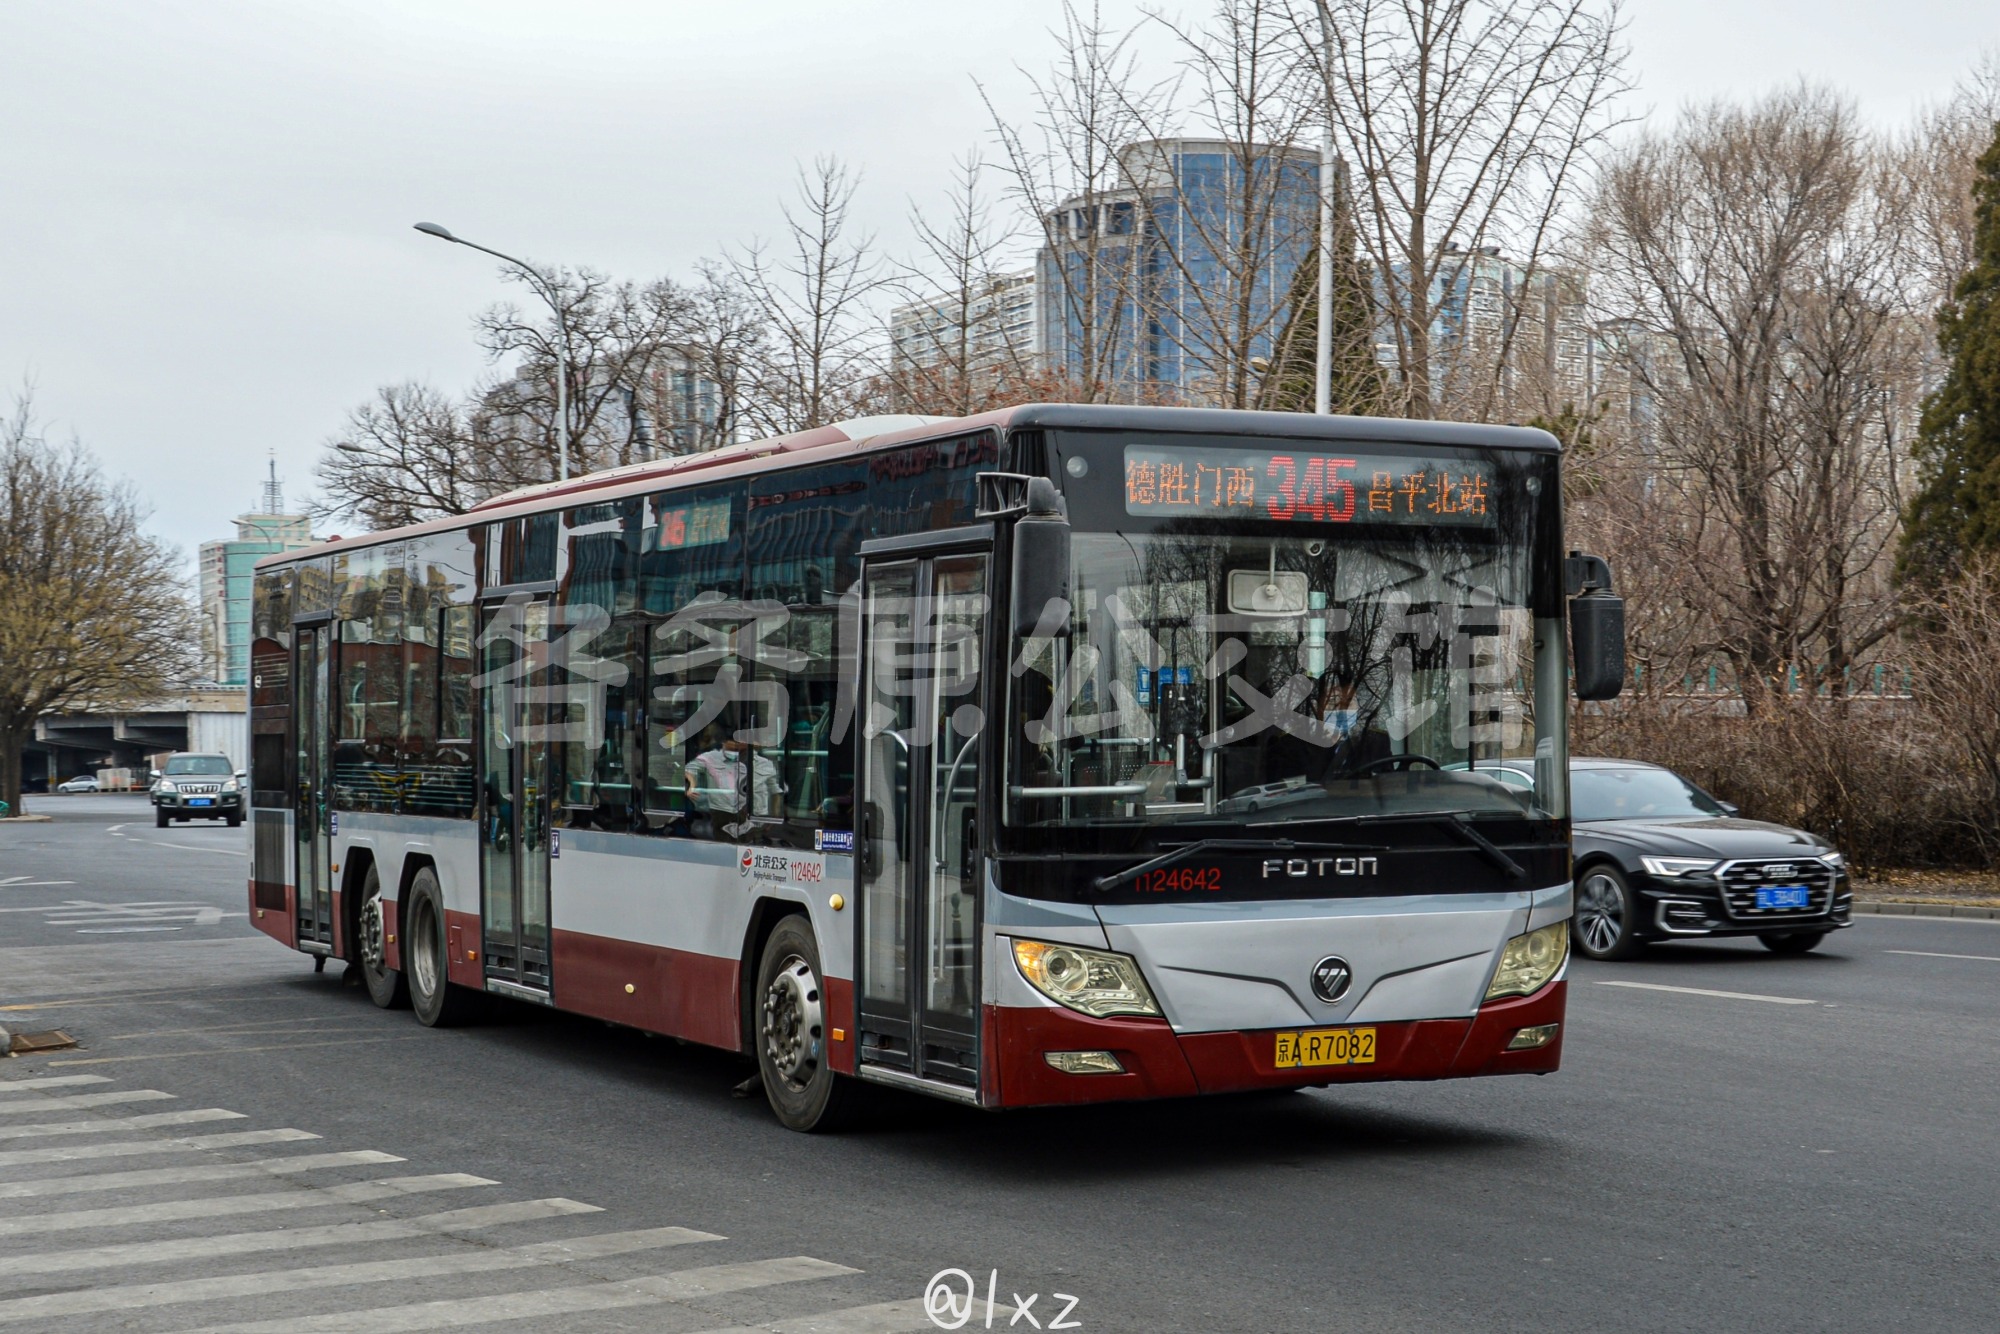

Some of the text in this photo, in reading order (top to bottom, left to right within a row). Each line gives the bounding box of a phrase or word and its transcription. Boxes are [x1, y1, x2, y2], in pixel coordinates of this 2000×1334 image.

[1126, 455, 1487, 523] 德胜门西 345 昌平北站
[754, 855, 787, 870] 北京公交
[790, 861, 821, 883] 1124642
[1262, 857, 1378, 879] FOTON
[1135, 866, 1222, 892] 1124642
